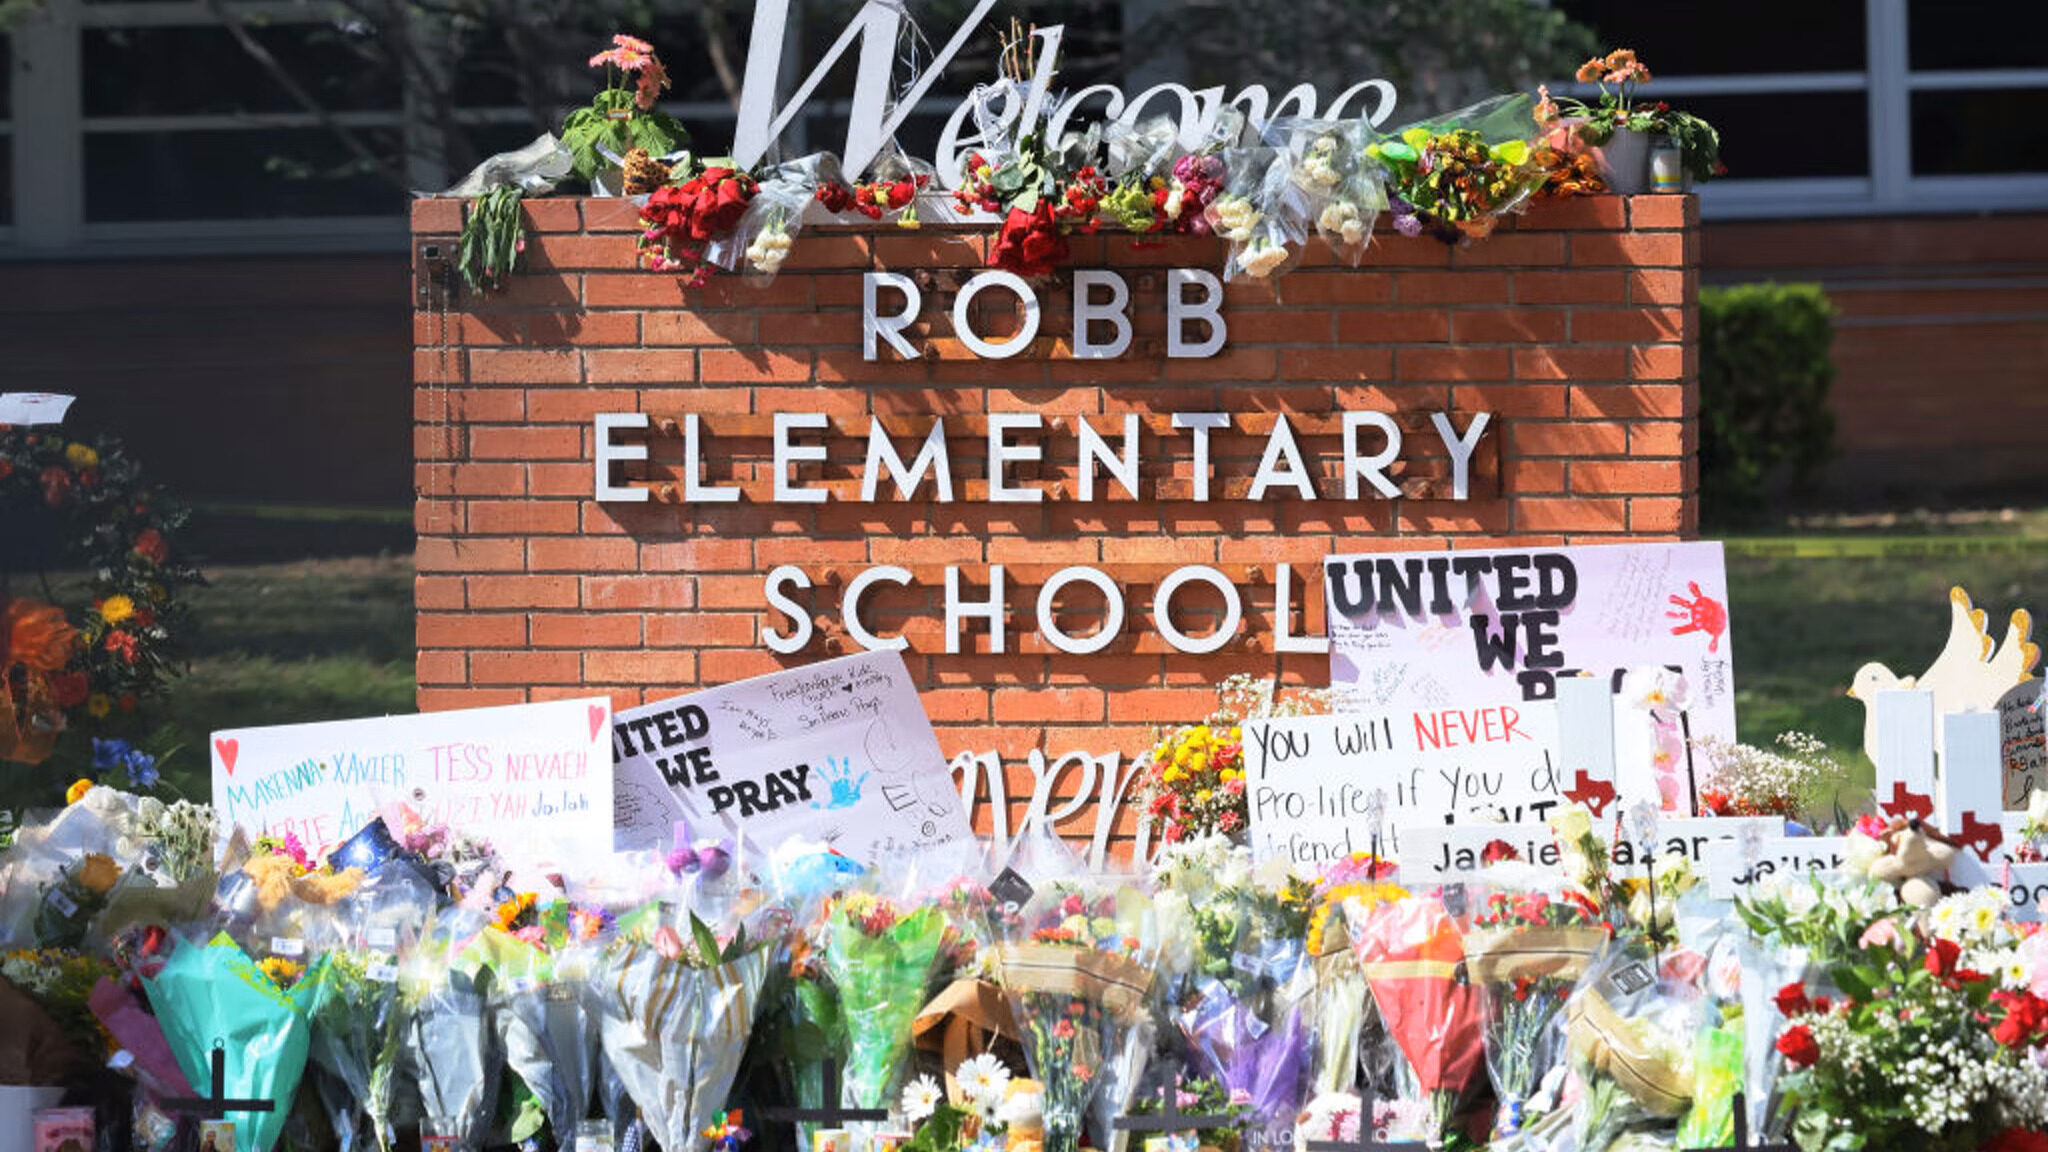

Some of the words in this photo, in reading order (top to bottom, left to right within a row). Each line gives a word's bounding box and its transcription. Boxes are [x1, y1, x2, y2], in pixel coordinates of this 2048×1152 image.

[733, 0, 1397, 192] Welcome
[864, 268, 1227, 361] ROBB
[594, 411, 1493, 503] ELEMENTARY
[762, 563, 1326, 655] SCHOOL
[1327, 554, 1578, 617] UNITED
[1469, 611, 1565, 671] WE
[612, 704, 711, 764] ITED
[1413, 706, 1534, 752] NEVER
[226, 757, 325, 821] MAKENNA
[332, 751, 406, 787] XAVIER
[426, 743, 493, 783] TESS
[506, 750, 588, 785] NEVAEH
[655, 747, 720, 788] WE
[708, 764, 813, 818] PRAY
[1433, 840, 1557, 873] Jaie
